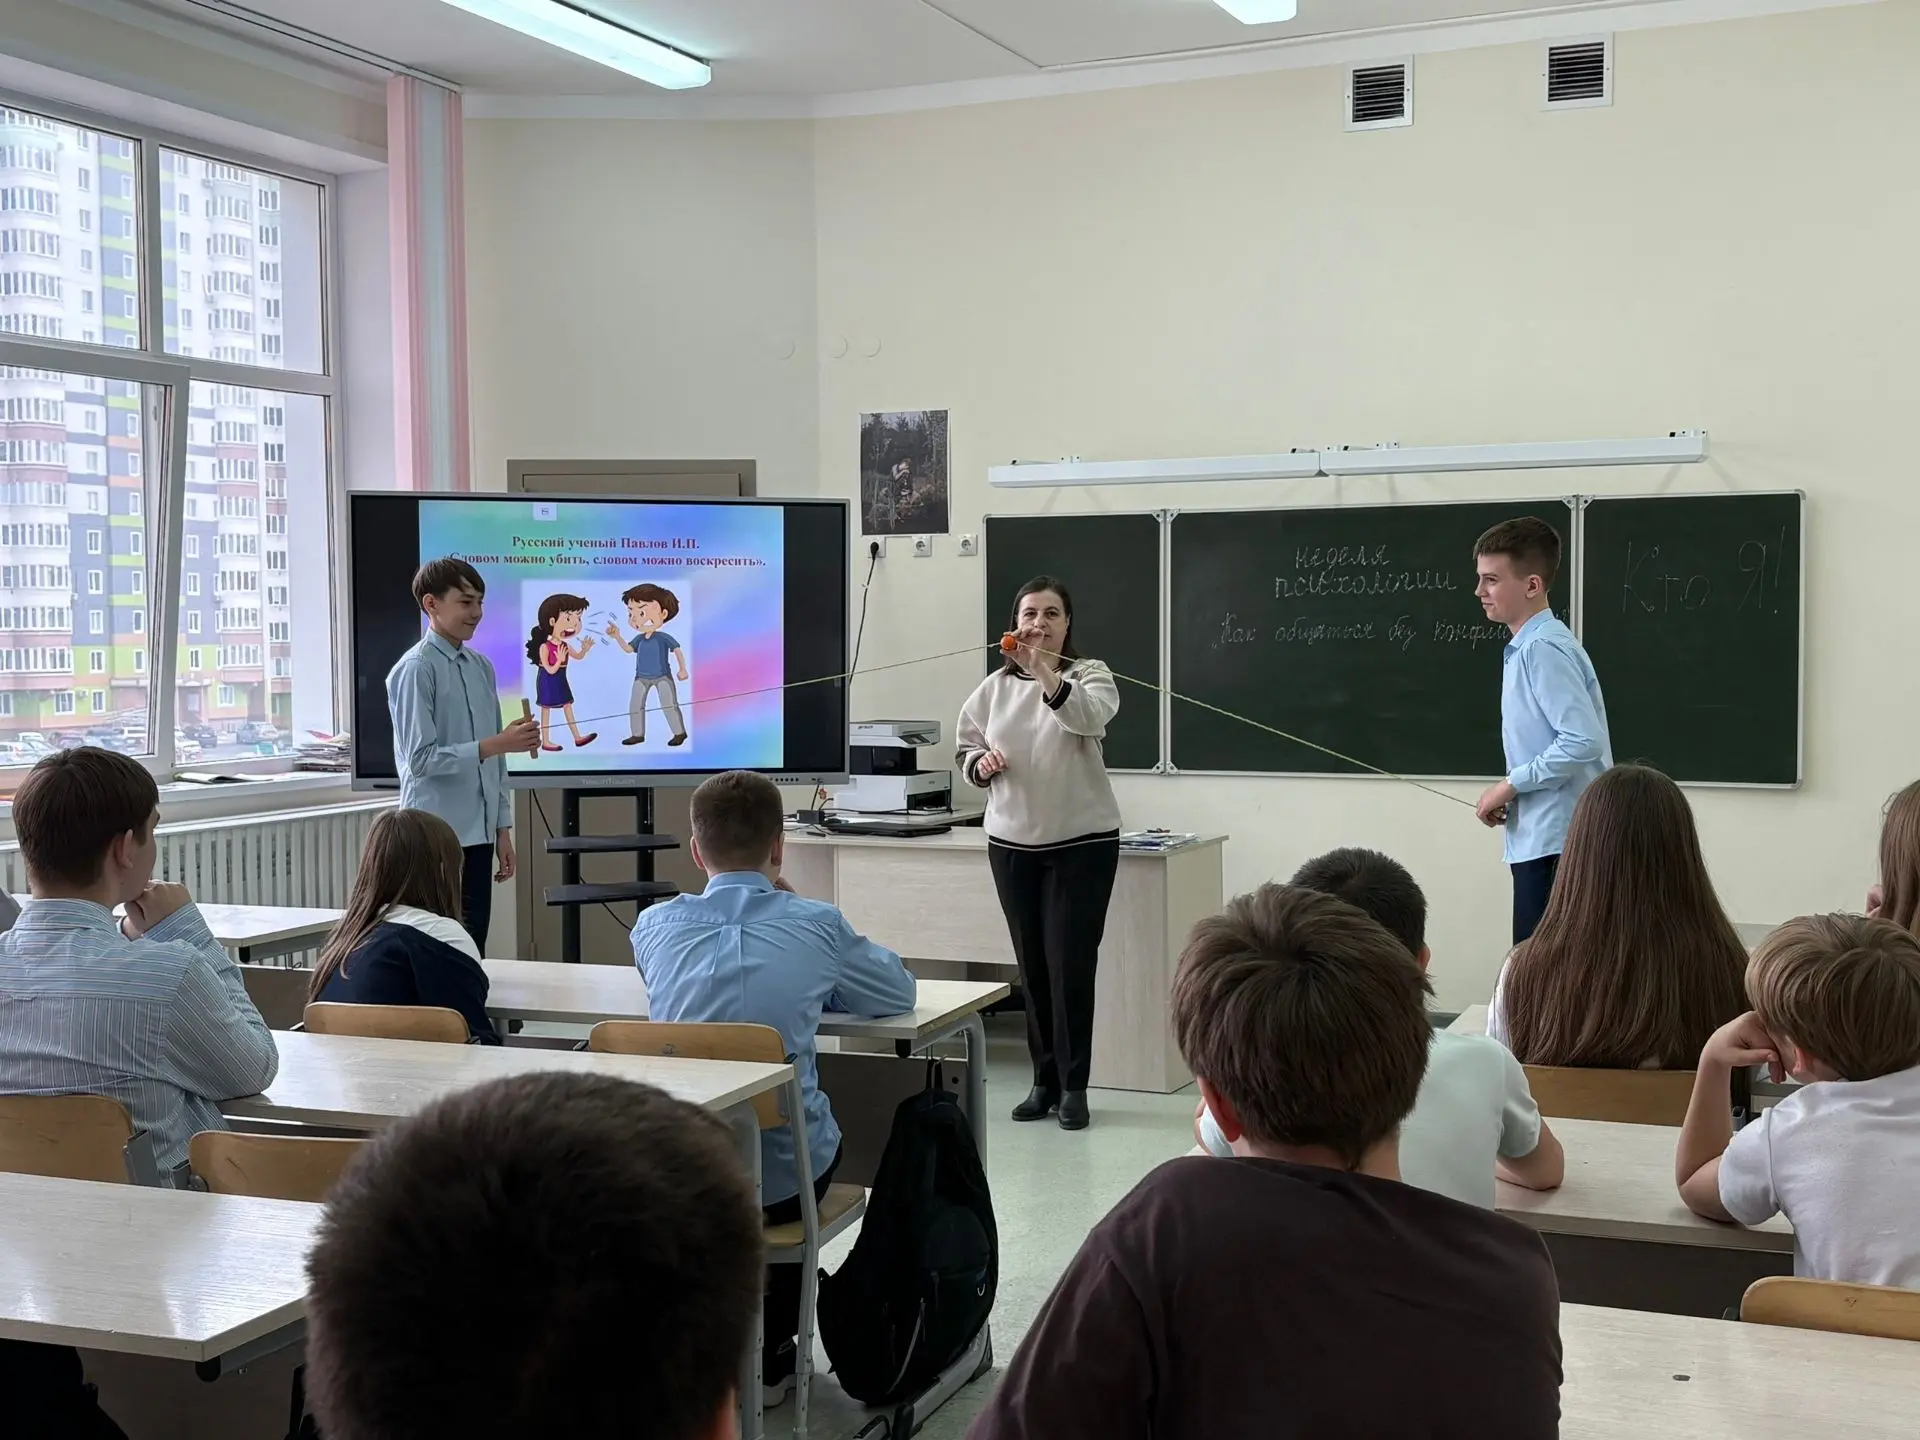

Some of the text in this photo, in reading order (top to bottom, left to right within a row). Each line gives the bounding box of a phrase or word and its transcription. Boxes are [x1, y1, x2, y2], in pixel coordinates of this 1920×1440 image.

[512, 536, 700, 551] Русский ученый Павлов И.П.
[503, 553, 546, 565] можно
[549, 553, 590, 567] убить,
[593, 556, 638, 566] словом
[641, 556, 682, 567] можно
[1389, 615, 1417, 650] без
